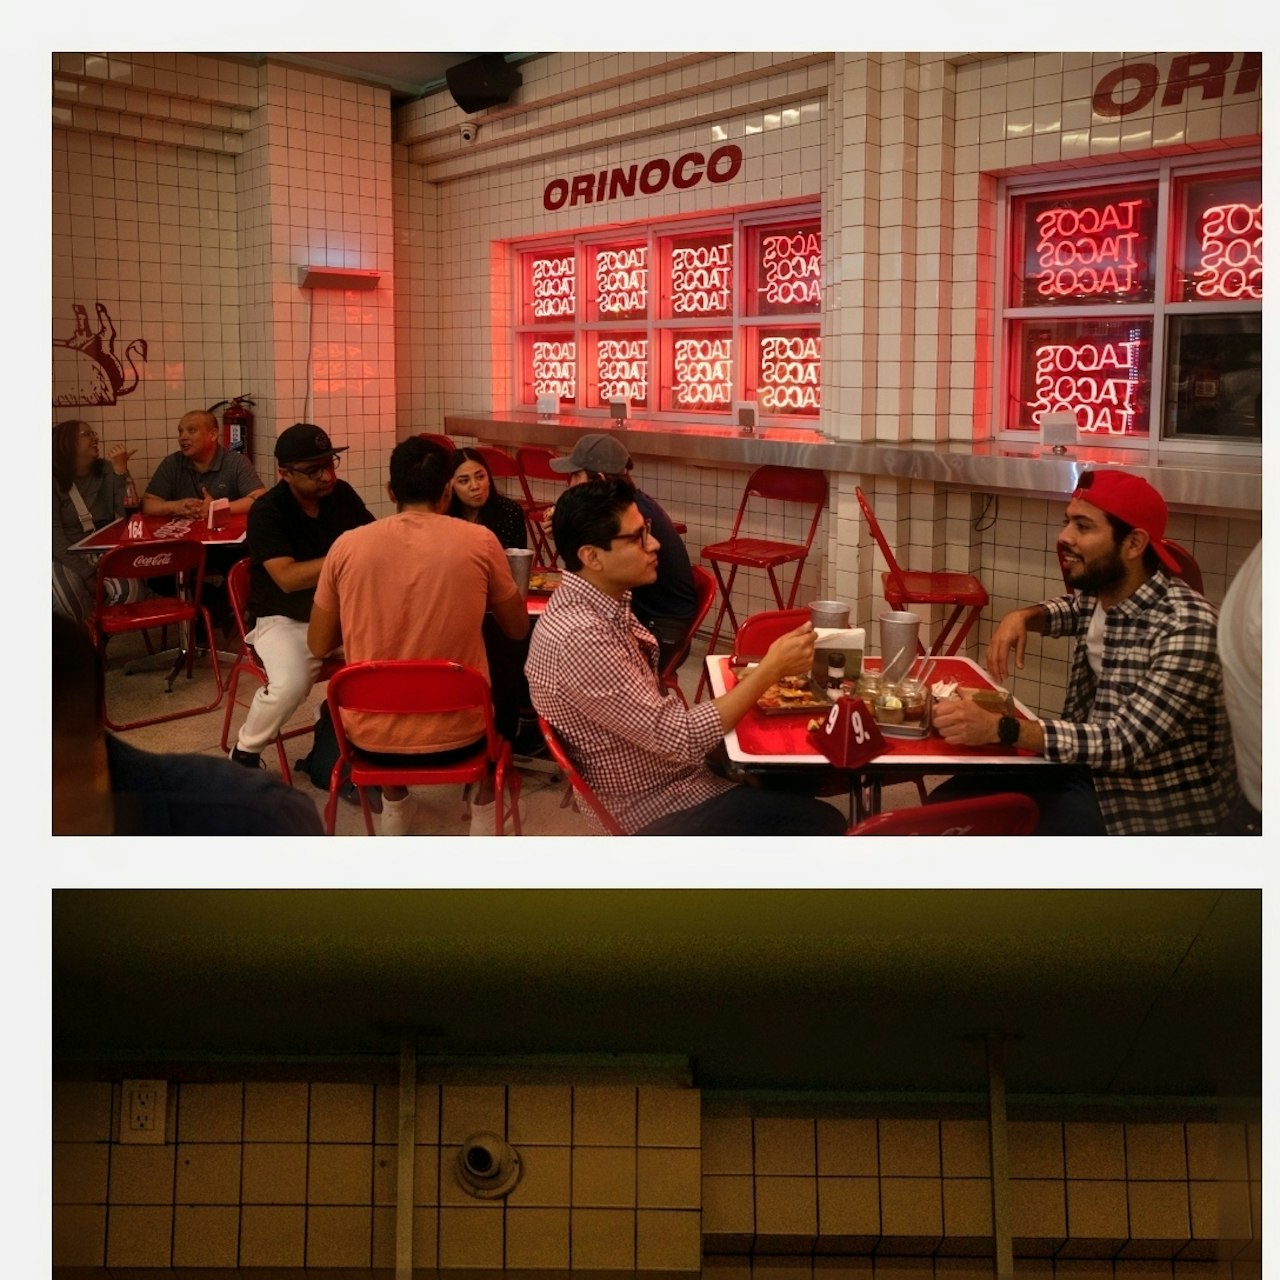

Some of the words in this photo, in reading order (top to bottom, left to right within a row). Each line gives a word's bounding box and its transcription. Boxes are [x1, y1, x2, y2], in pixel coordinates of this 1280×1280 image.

[543, 144, 743, 211] ORINOCO
[127, 520, 143, 538] 164
[133, 552, 172, 567] Coca-Cola
